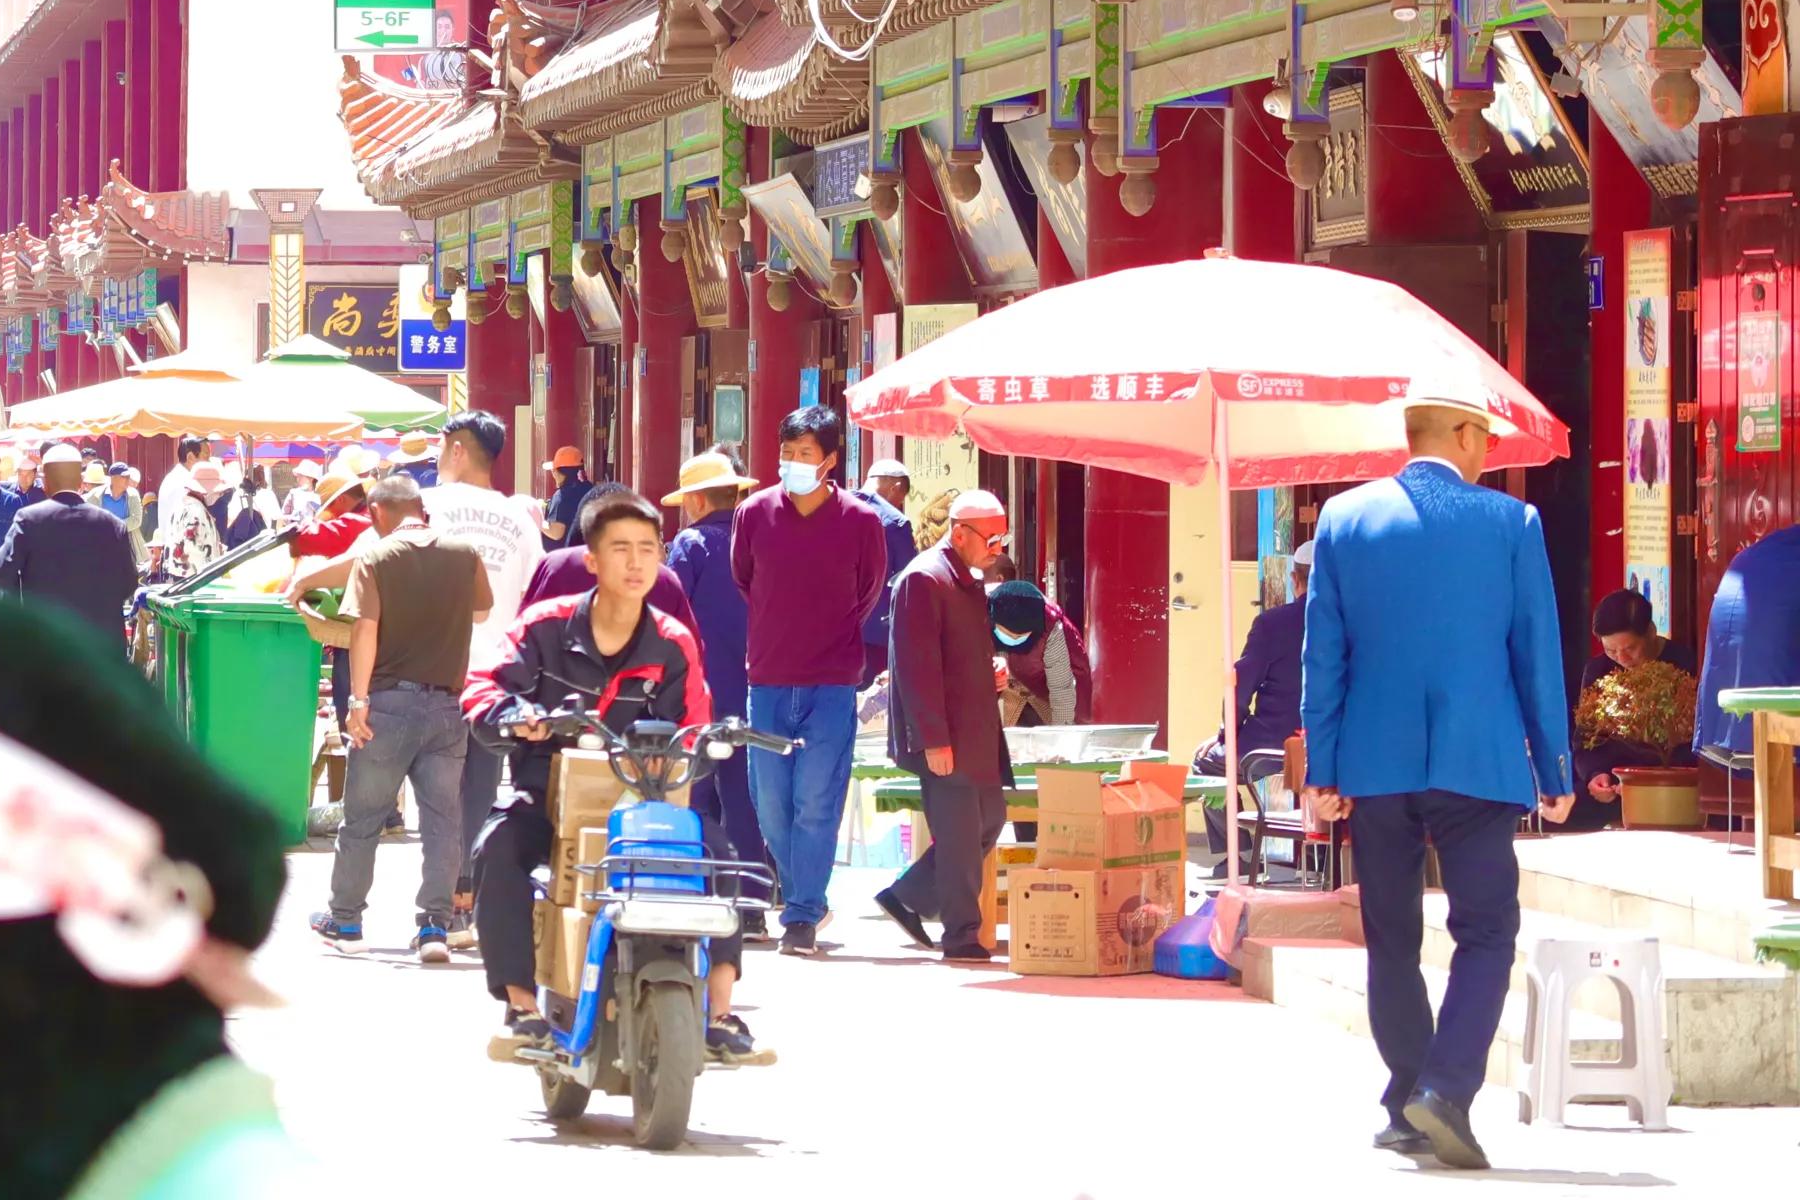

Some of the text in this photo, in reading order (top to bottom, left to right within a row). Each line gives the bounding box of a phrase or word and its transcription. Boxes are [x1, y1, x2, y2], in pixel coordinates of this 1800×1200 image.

[361, 11, 410, 27] 5-6F
[410, 335, 457, 354] 警务室
[977, 373, 1165, 403] 寄虫草 选顺丰
[1263, 378, 1305, 388] EXPRESS
[443, 507, 523, 539] WINDEN
